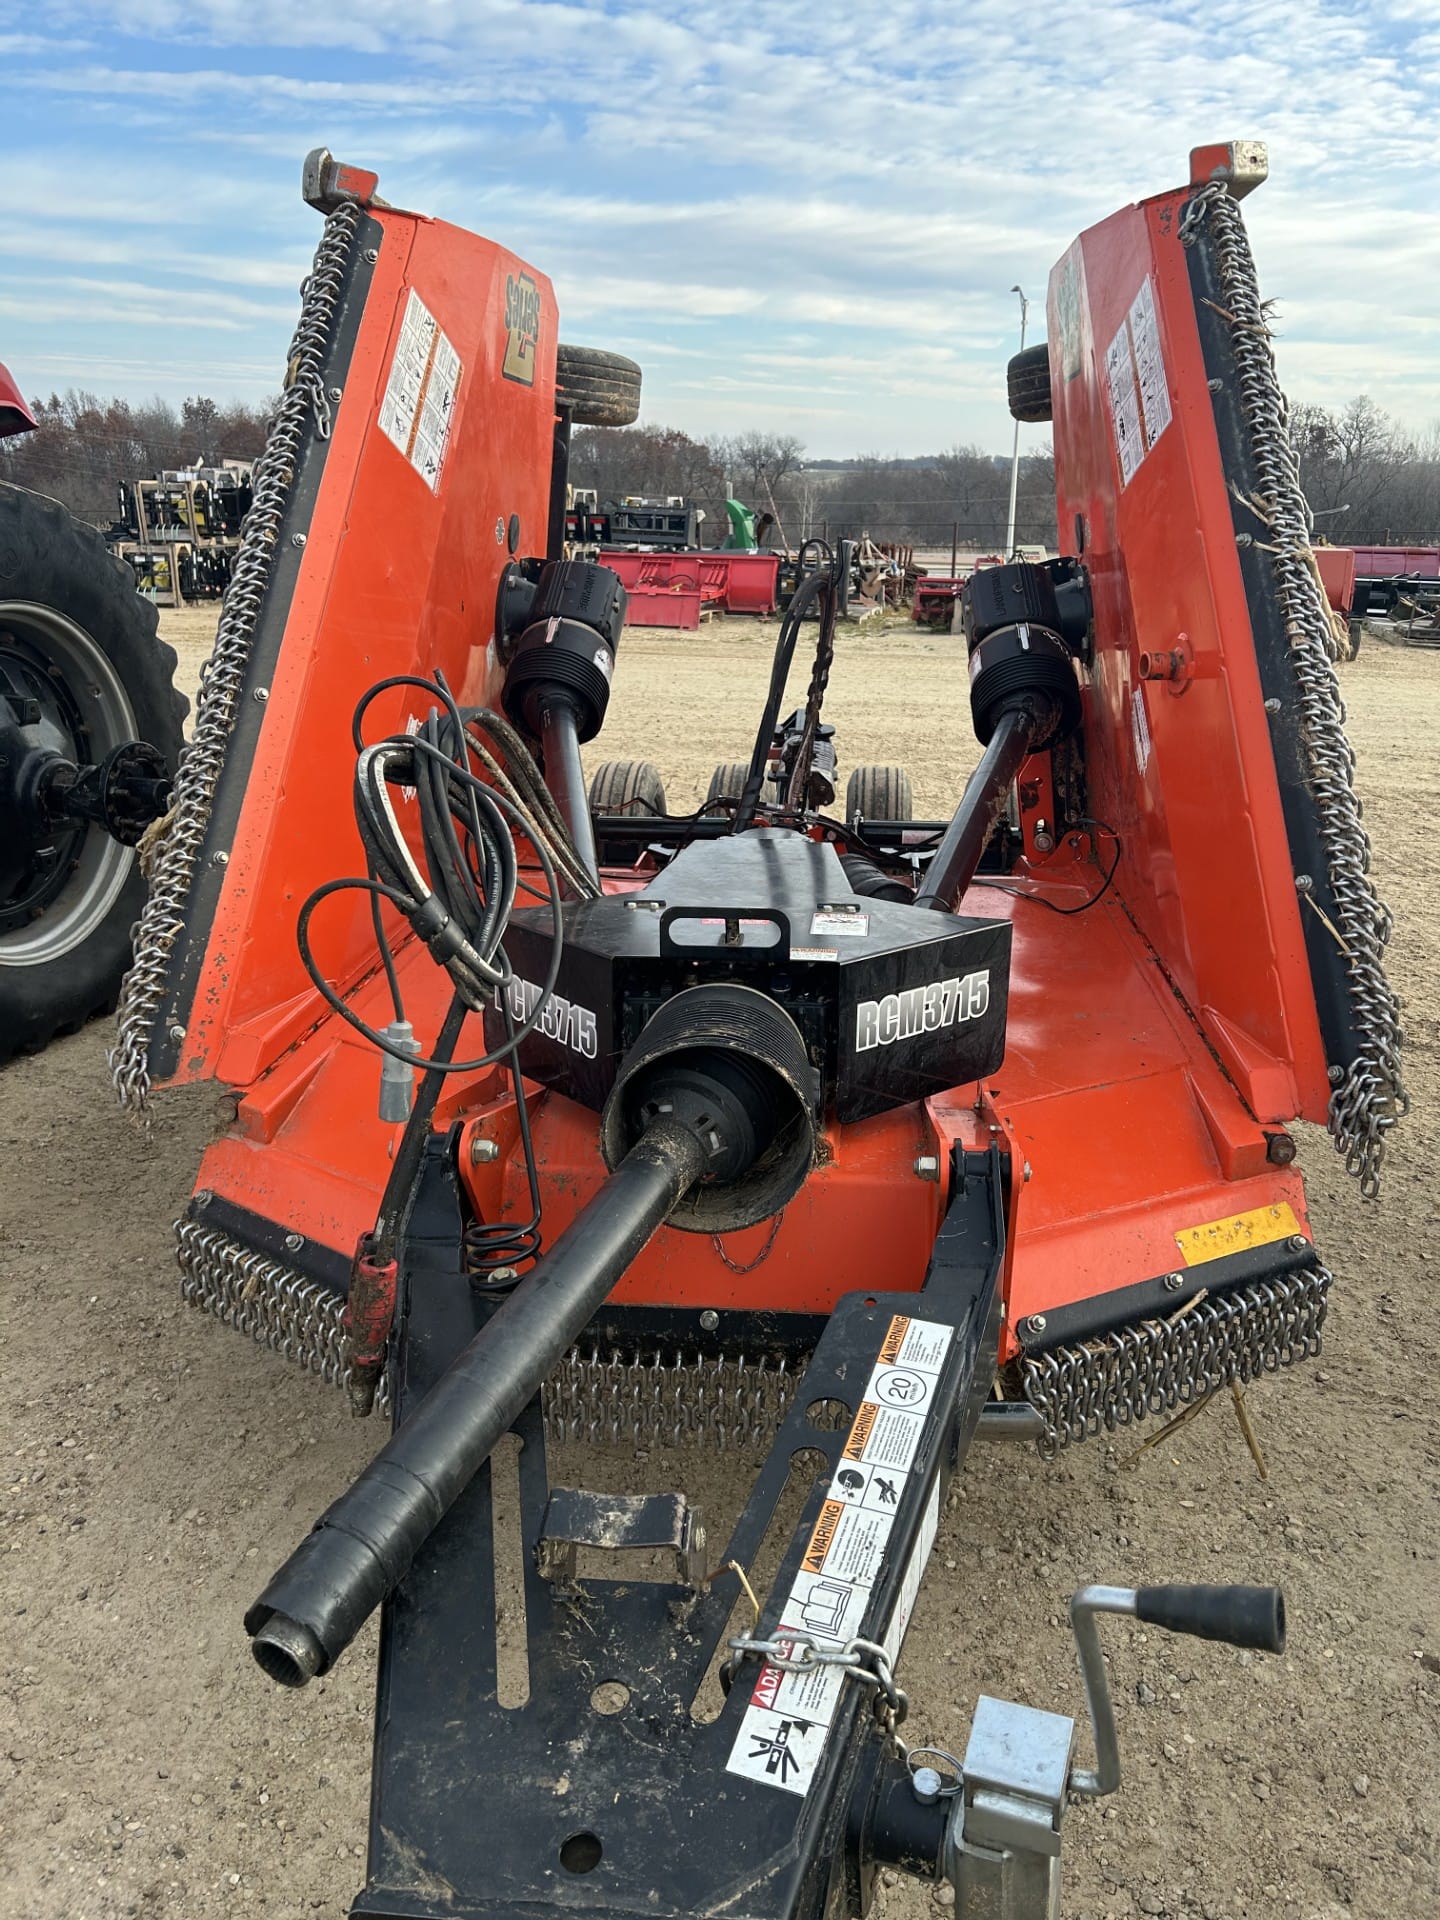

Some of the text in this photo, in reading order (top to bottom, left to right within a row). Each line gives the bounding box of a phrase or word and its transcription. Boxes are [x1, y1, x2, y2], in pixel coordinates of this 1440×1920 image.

[505, 274, 540, 343] Series
[855, 969, 990, 1053] RCM3715
[885, 1316, 908, 1352] WARNING
[888, 1378, 911, 1400] 20
[849, 1404, 877, 1446] WARNING
[810, 1504, 840, 1553] WARNING
